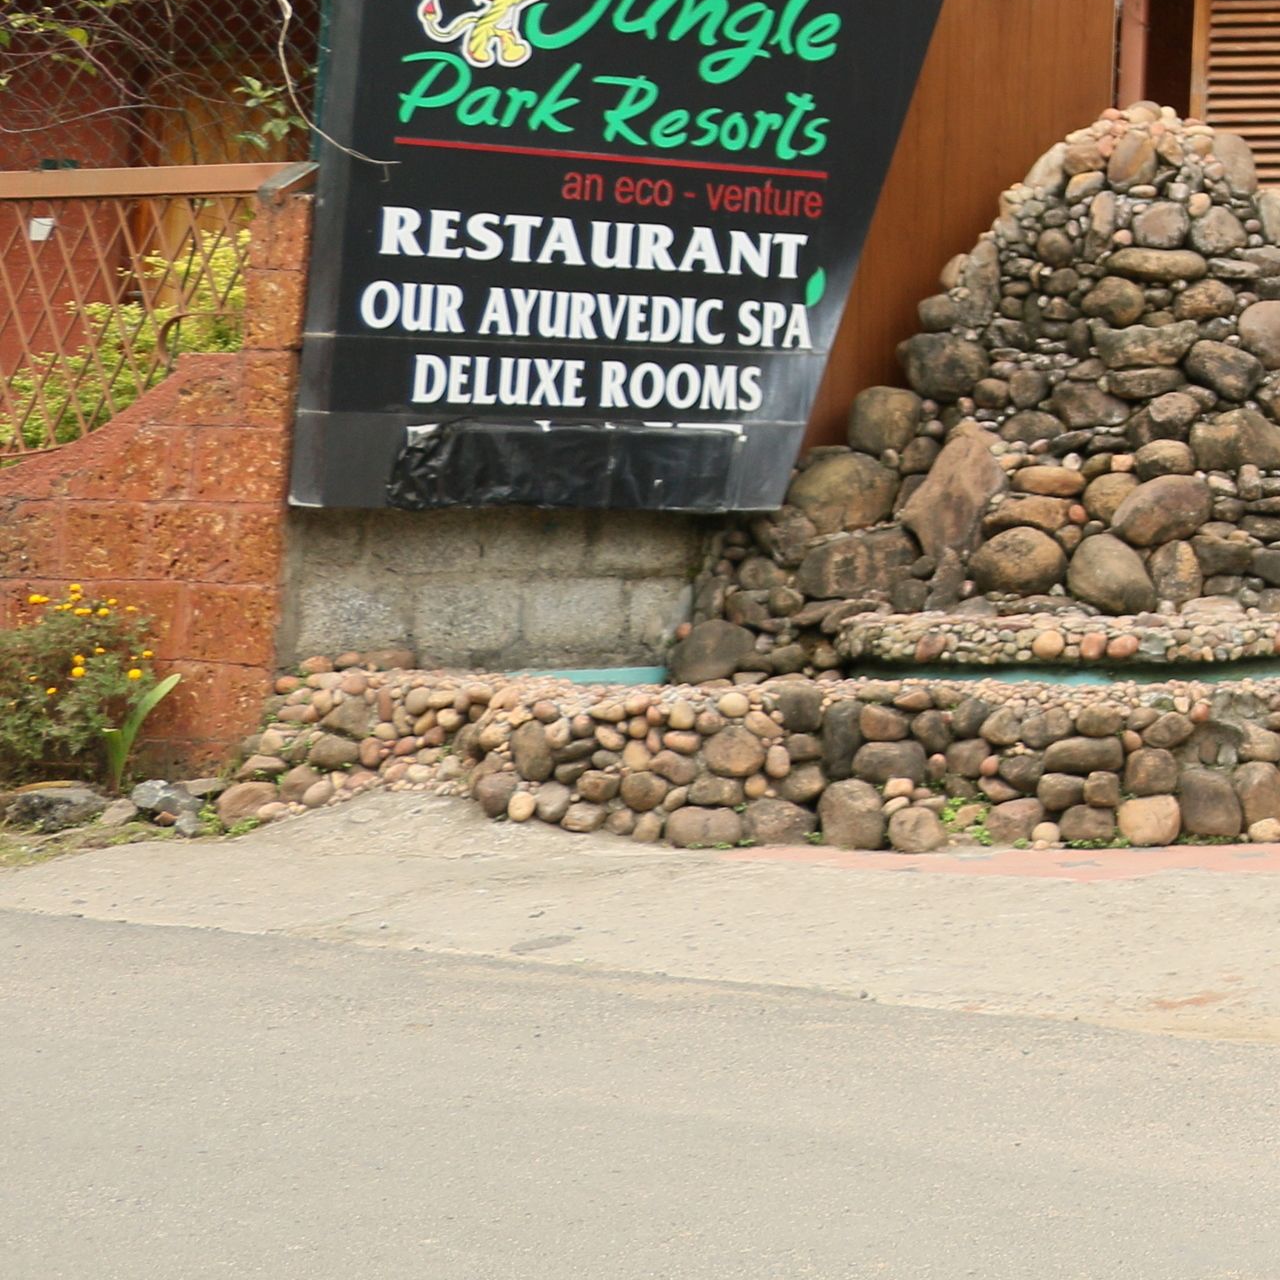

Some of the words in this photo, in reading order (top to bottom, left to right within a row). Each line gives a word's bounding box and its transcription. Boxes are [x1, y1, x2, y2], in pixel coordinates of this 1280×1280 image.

[398, 50, 582, 133] Park
[591, 75, 830, 161] Resorts
[561, 171, 604, 201] an
[613, 176, 675, 207] eco
[706, 179, 825, 219] venture
[378, 206, 809, 279] RESTAURANT
[360, 280, 466, 334] OUR
[477, 287, 726, 345] AYURVEDIC
[737, 300, 812, 350] SPA
[411, 354, 587, 407] DELUXE
[599, 360, 764, 412] ROOMS
